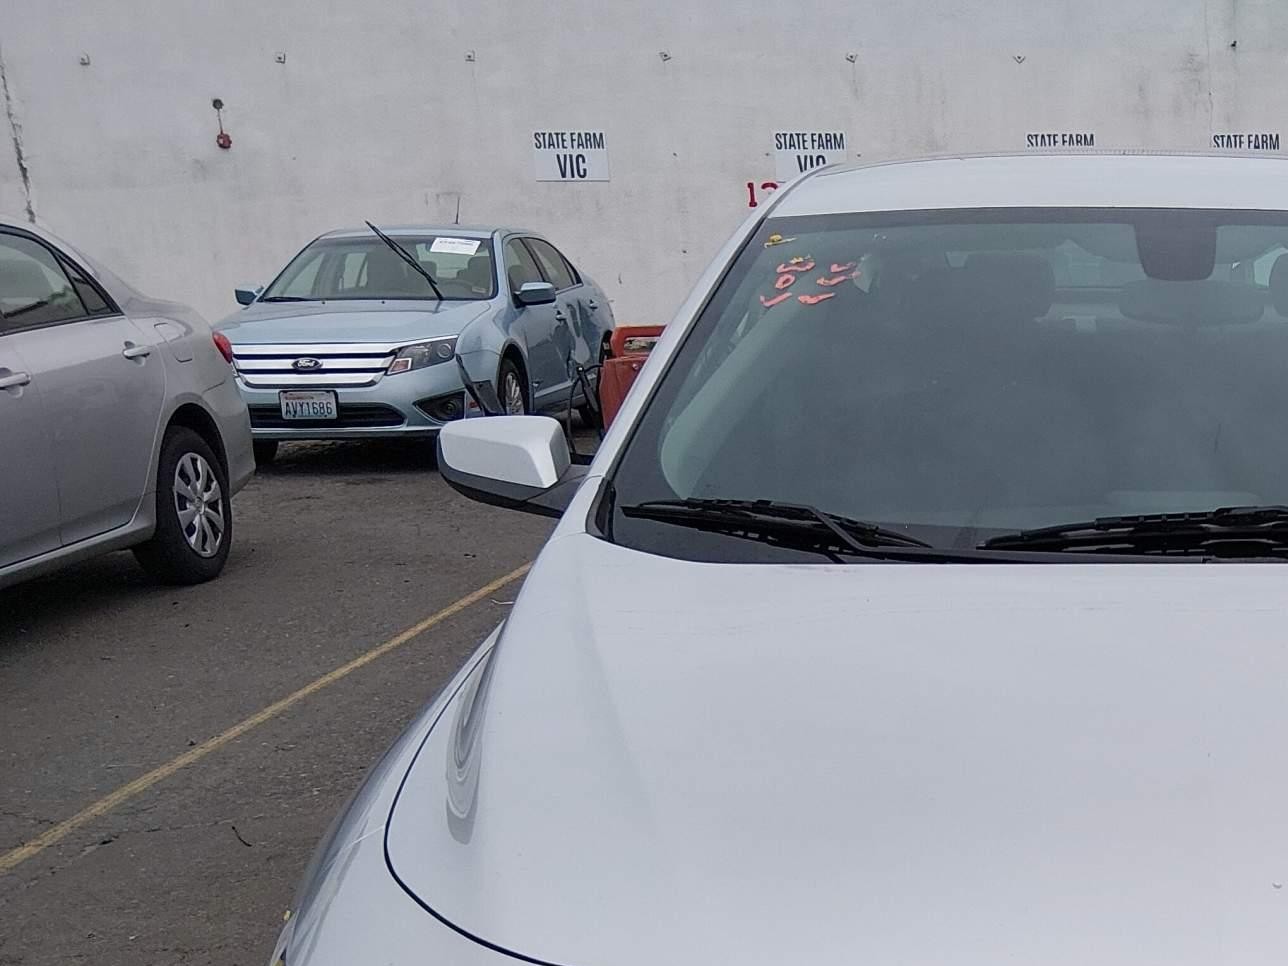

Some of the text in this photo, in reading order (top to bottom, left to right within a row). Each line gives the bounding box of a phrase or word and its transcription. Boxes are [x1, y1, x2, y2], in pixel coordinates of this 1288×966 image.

[533, 132, 605, 150] STATE FARM
[774, 132, 845, 150] STATE FARM
[1213, 133, 1280, 150] STATE FARM
[556, 153, 587, 179] VIC
[285, 401, 333, 415] AVY1686
